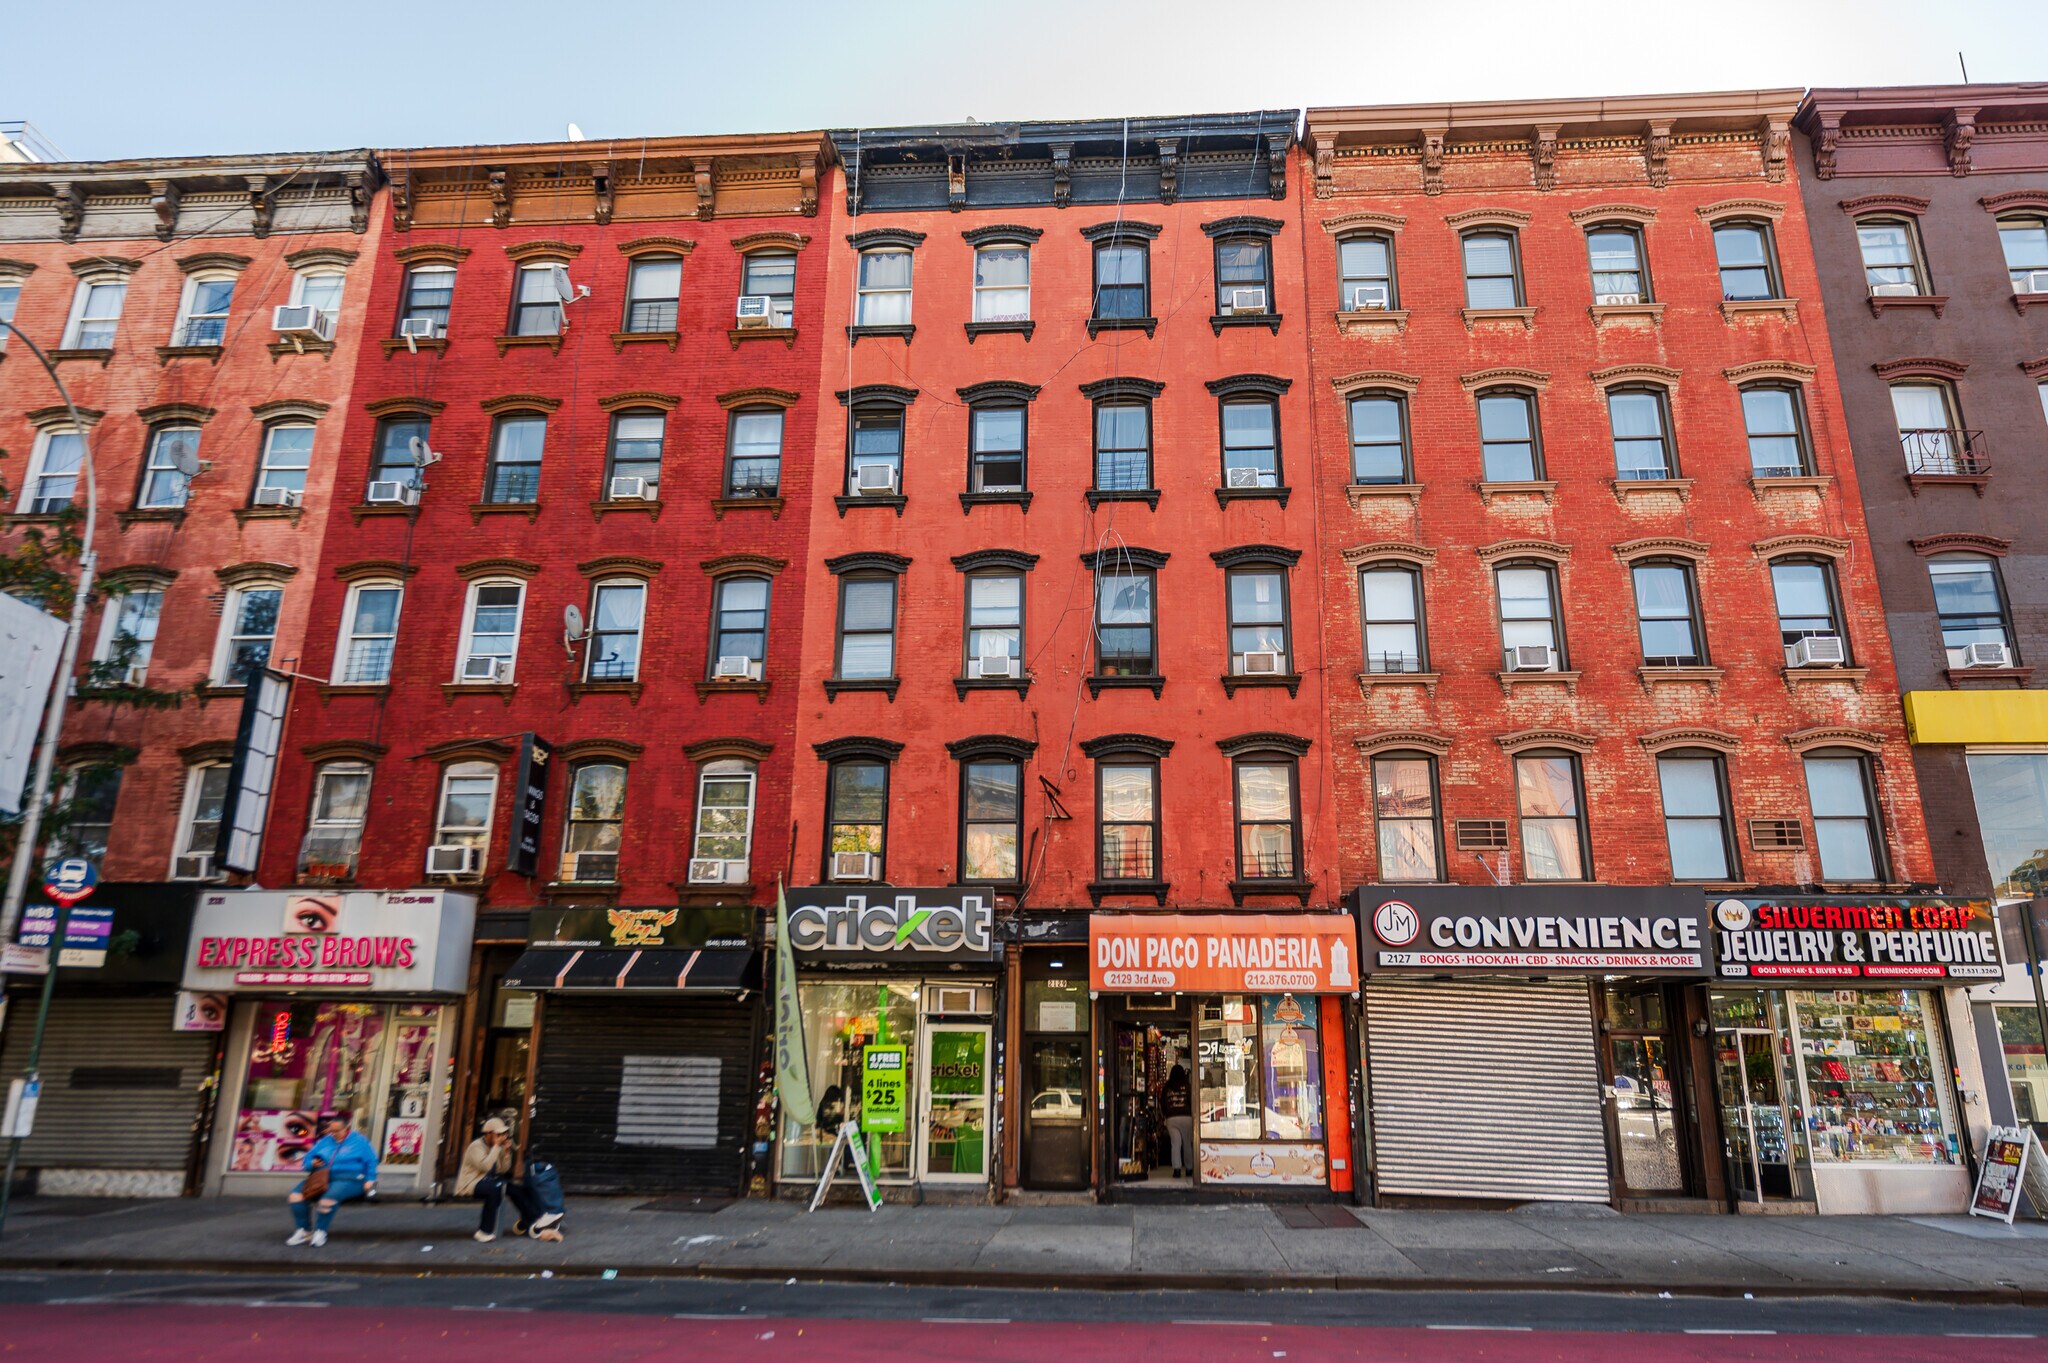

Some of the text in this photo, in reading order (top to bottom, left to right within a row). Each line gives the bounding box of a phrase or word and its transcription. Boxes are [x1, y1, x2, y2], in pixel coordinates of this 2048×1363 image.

[788, 895, 991, 950] cricket
[1758, 906, 1976, 930] SILVERMEN CORP
[1430, 915, 1701, 949] CONVENIENCE
[198, 936, 416, 968] EXPRESS BROWS
[1097, 937, 1323, 969] DON PACO PANADERIA
[1721, 931, 1998, 963] JEWELRY & PERFUME
[1387, 954, 1411, 964] 2127
[1419, 954, 1695, 965] BONGS HOOKAH CBD SNACKS DRINKS & MORE
[1952, 967, 1998, 975] 917.531.3260
[1110, 972, 1170, 985] 2129 3rd Ave.
[1247, 973, 1315, 986] 212.876.0700
[869, 1053, 901, 1062] 4 FREE
[931, 1063, 980, 1077] cricket
[867, 1079, 901, 1088] 4 lines
[866, 1089, 896, 1105] $25
